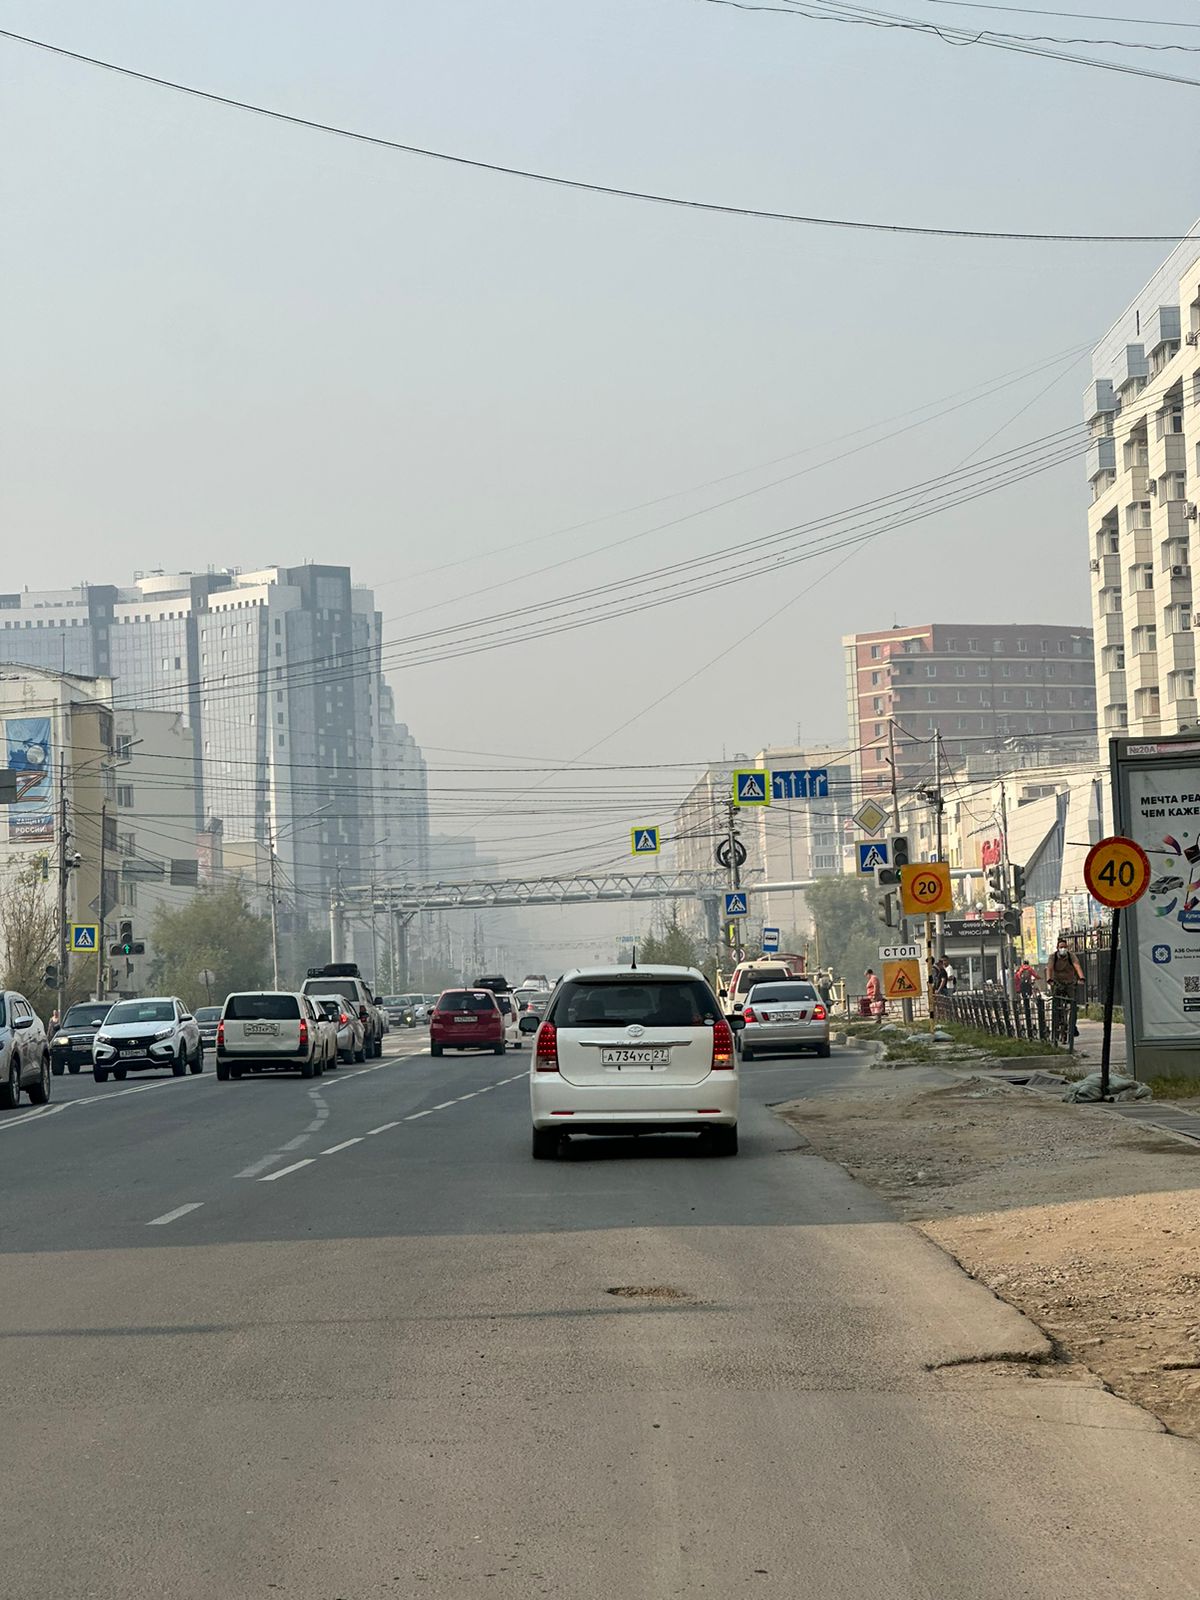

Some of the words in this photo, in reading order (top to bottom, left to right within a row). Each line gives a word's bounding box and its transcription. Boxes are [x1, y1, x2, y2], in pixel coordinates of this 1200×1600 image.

[1140, 795, 1179, 805] МЕЧТА
[1141, 809, 1165, 818] ЧЕМ
[1168, 807, 1200, 816] КАЖЕ
[1098, 859, 1135, 887] 40
[918, 881, 937, 895] 20
[883, 946, 916, 957] СТОП
[607, 1050, 651, 1062] А734УС
[653, 1049, 665, 1059] 27
